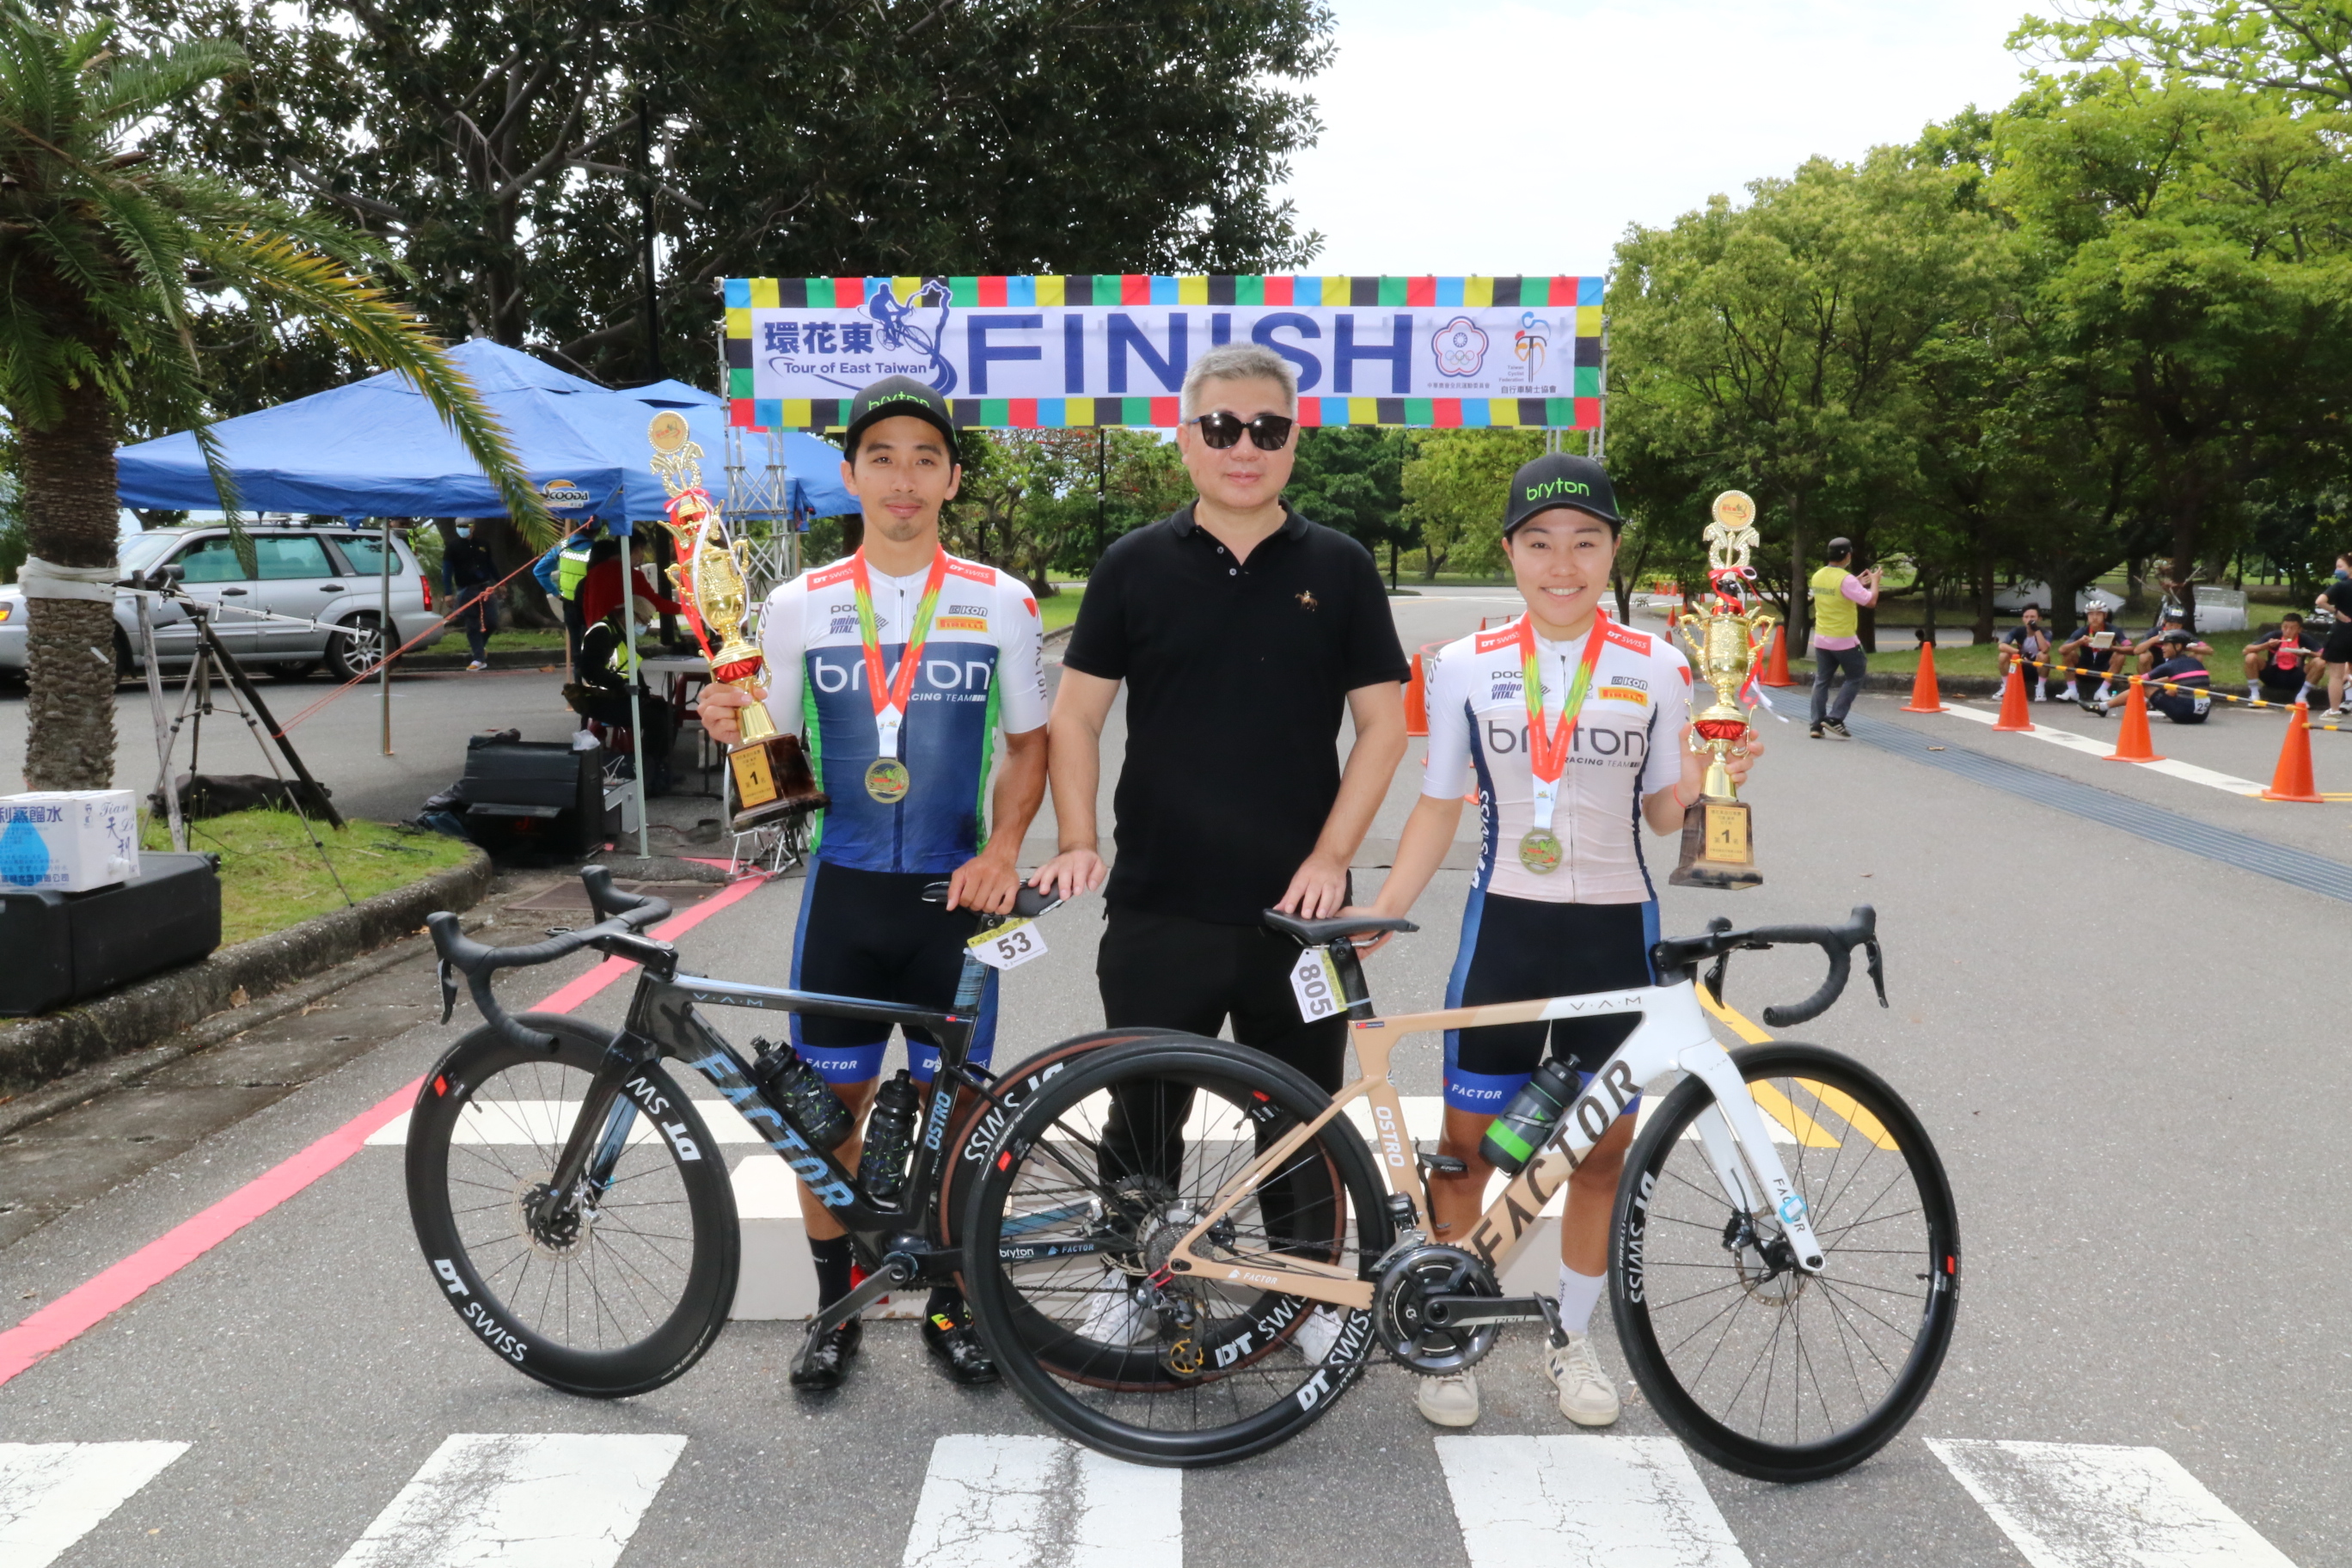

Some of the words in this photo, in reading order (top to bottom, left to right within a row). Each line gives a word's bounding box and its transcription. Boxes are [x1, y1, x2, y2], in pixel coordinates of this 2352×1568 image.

[764, 322, 874, 354] 環花東
[784, 362, 816, 374] Tour
[820, 362, 836, 374] of
[840, 362, 871, 374] East
[875, 362, 927, 374] Taiwan
[1501, 385, 1557, 394] 自行車騎士協會
[1526, 476, 1589, 501] bryton
[813, 575, 828, 584] DT
[829, 567, 854, 580] SWISS
[949, 564, 964, 573] DT
[963, 567, 989, 579] SWISS
[830, 625, 854, 634] VITAL
[940, 619, 984, 630] PIRELLI
[1497, 631, 1520, 645] SWISS
[1607, 630, 1622, 640] DT
[1621, 635, 1648, 650] SWISS
[816, 656, 992, 694] bron
[1491, 682, 1522, 692] amino
[1491, 690, 1516, 701] VITAL
[905, 693, 942, 701] ACING
[946, 694, 973, 702] TEAM
[1488, 720, 1645, 756] brton
[750, 770, 758, 786] 1
[0, 805, 63, 824] 利蒸餾水
[100, 801, 128, 817] Tian
[1722, 829, 1730, 843] 1
[997, 932, 1032, 960] 53
[1298, 964, 1333, 1016] 805
[1452, 1083, 1503, 1099] FACTOR
[688, 1052, 854, 1209] FACTOR
[925, 1091, 952, 1151] OSTRO
[661, 1121, 701, 1161] DT
[1375, 1106, 1405, 1167] OSTRO
[1471, 1059, 1645, 1270] FACTOR
[1773, 1178, 1806, 1233] FACOR
[999, 1247, 1034, 1259] bryton
[1062, 1244, 1094, 1253] FACTOR
[1629, 1222, 1645, 1303] SWISS
[1243, 1272, 1278, 1284] FACTOR
[434, 1259, 469, 1296] DT
[463, 1302, 527, 1362] SWISS
[1215, 1332, 1253, 1368] DT
[1258, 1294, 1308, 1341] SWI
[1296, 1369, 1331, 1412] DT
[1328, 1308, 1371, 1374] SWIS
